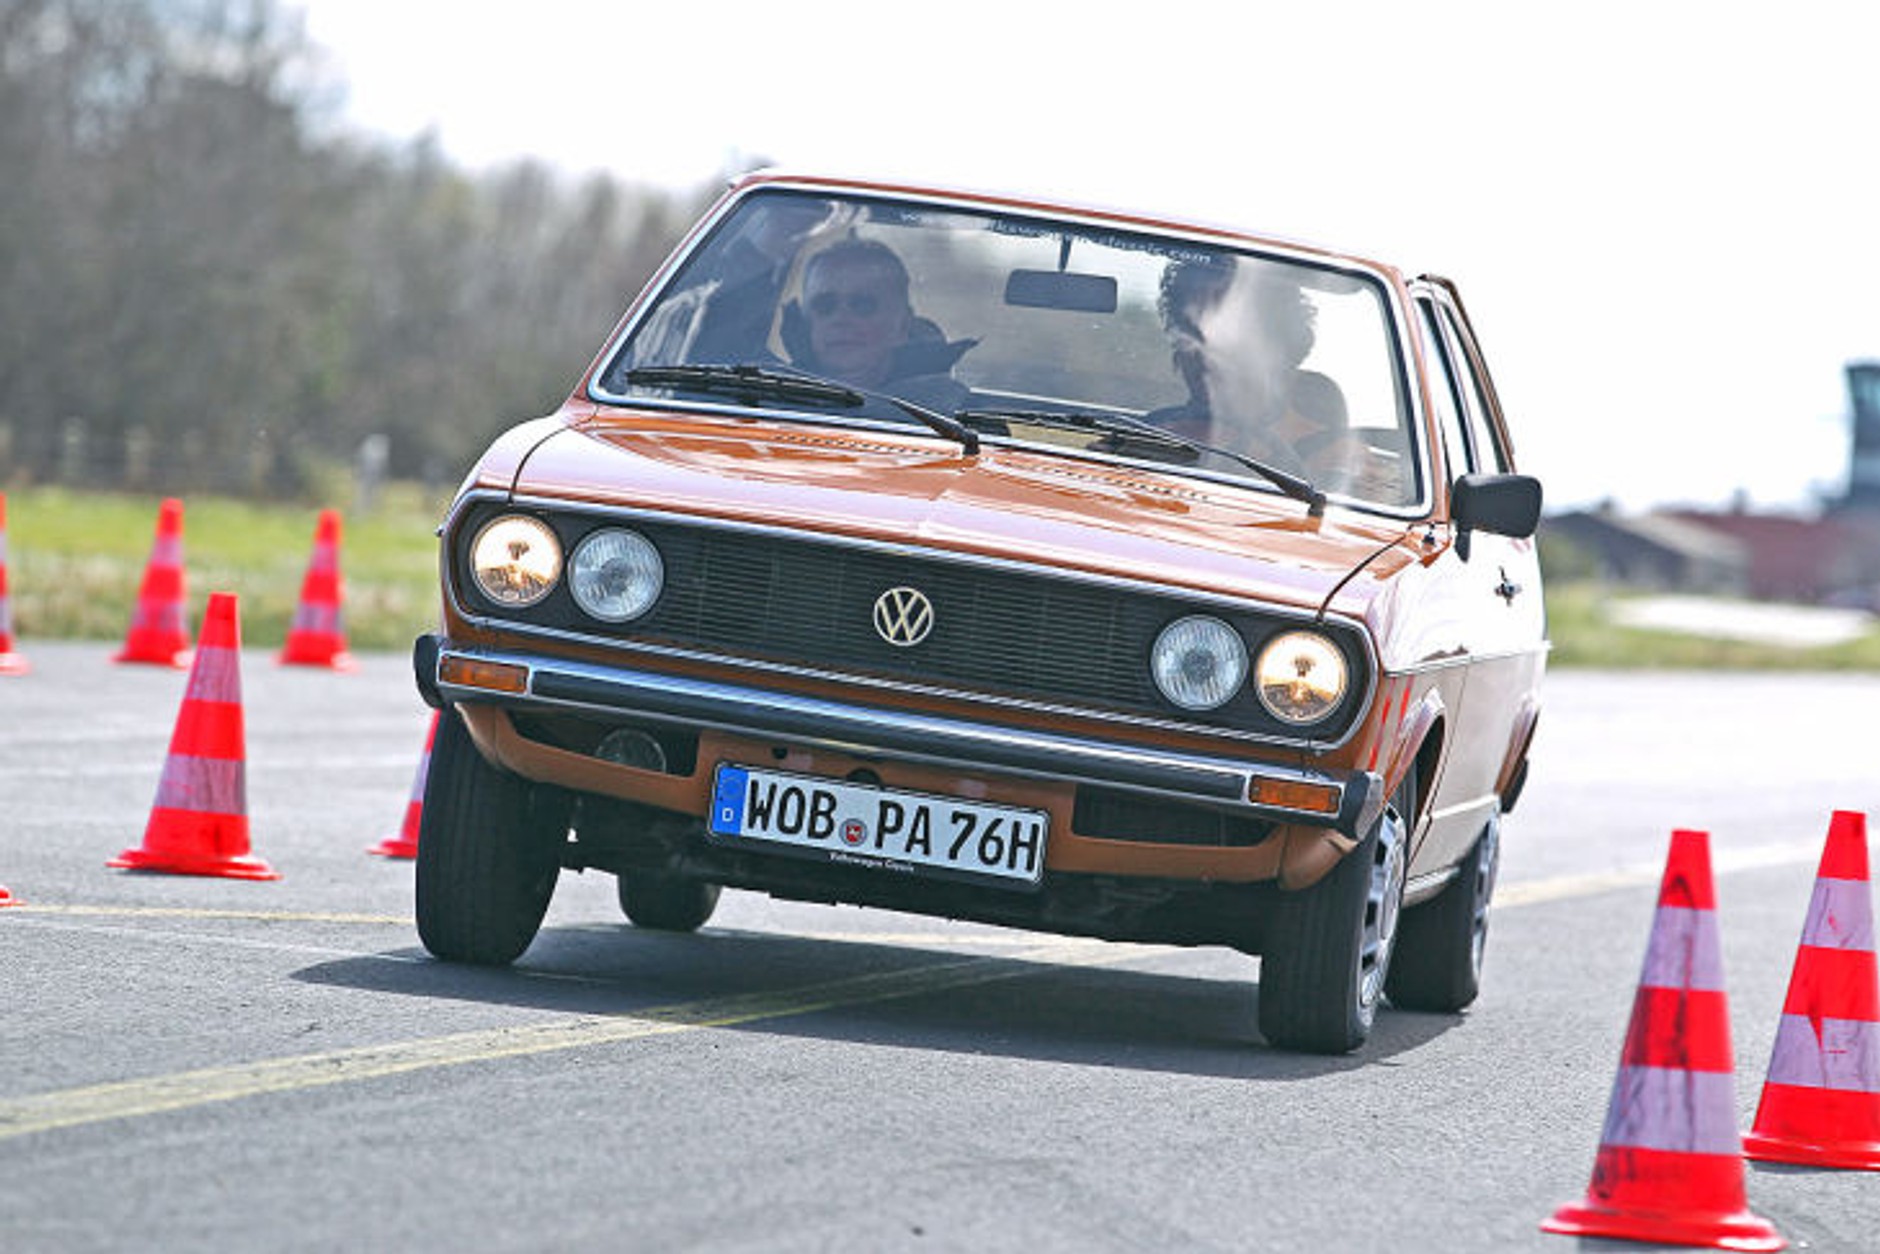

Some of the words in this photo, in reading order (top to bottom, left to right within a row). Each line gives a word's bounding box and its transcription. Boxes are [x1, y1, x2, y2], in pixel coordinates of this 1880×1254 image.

[874, 586, 934, 646] VW
[721, 807, 735, 822] D
[747, 779, 838, 840] WOB
[874, 799, 932, 857] PA
[948, 810, 1042, 874] 76H
